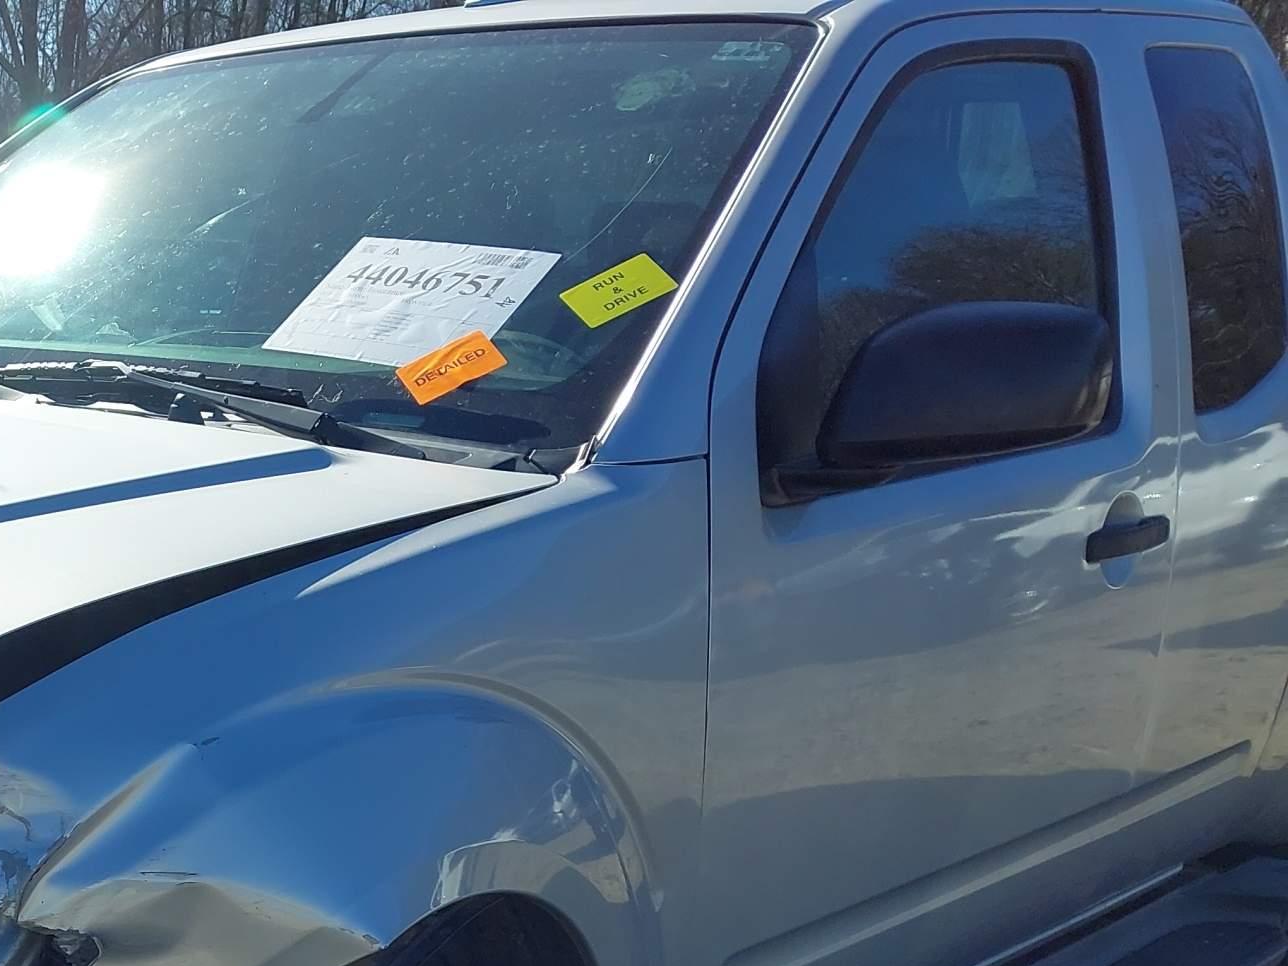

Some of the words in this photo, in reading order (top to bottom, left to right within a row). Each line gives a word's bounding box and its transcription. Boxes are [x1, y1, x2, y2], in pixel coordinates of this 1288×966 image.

[347, 263, 506, 298] 44046751
[593, 271, 625, 291] RUN
[613, 286, 625, 294] &
[603, 285, 649, 311] DRIVE
[414, 348, 486, 387] DETAILED
